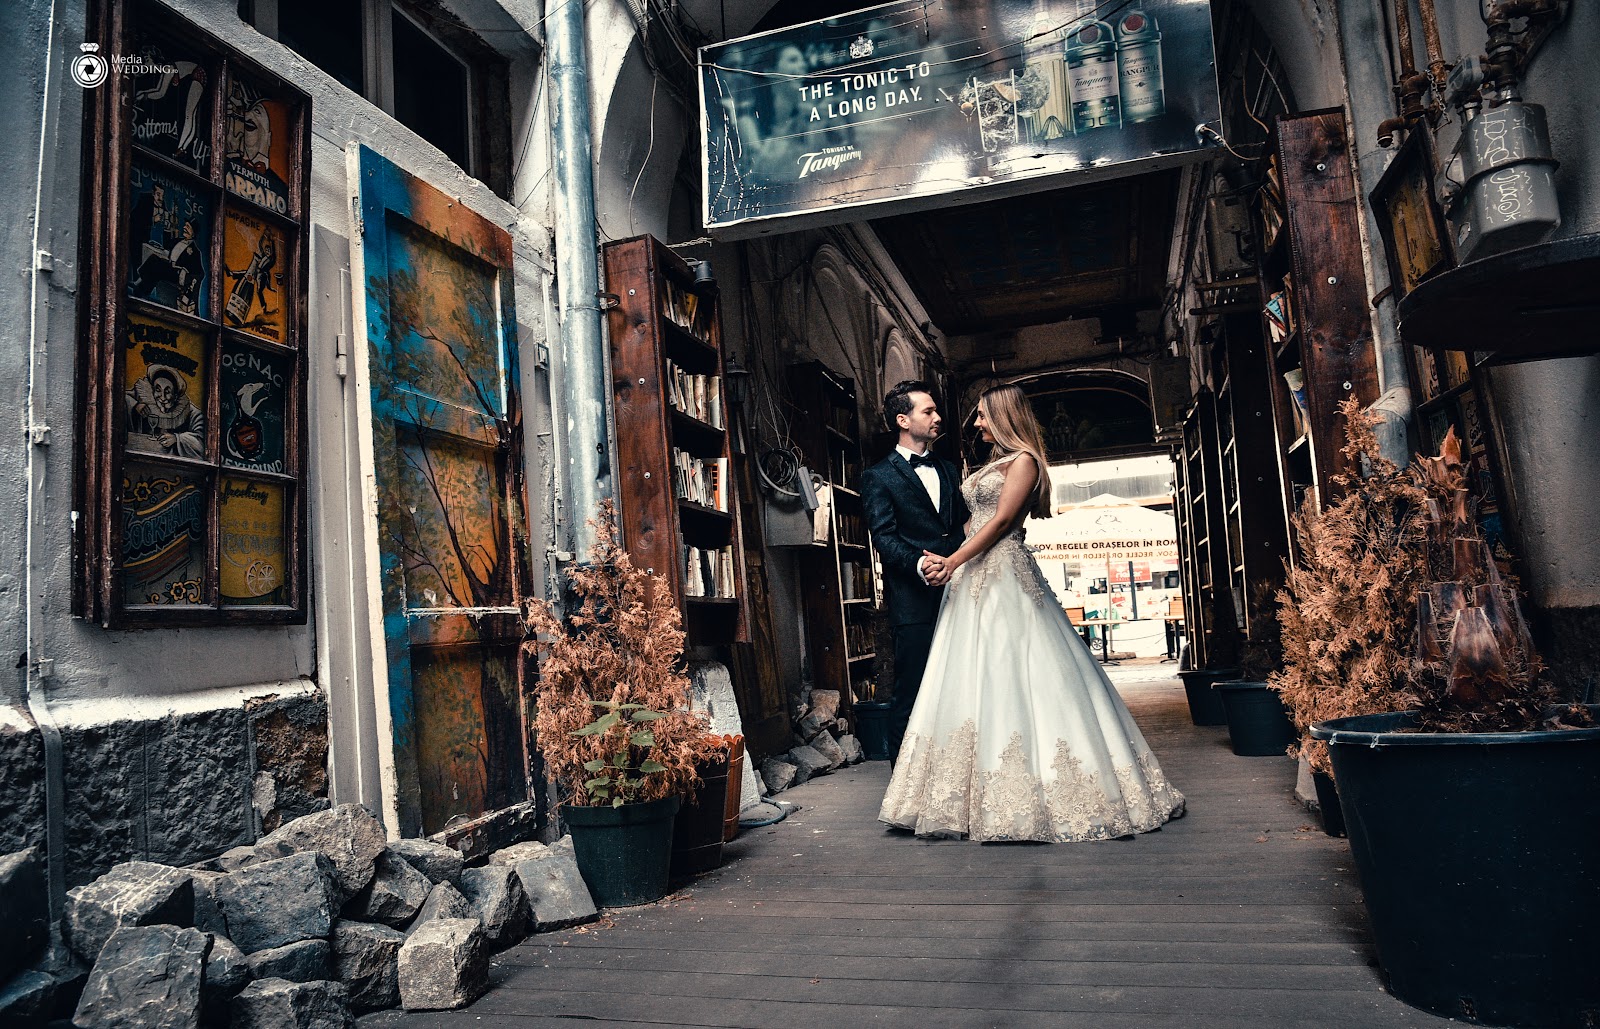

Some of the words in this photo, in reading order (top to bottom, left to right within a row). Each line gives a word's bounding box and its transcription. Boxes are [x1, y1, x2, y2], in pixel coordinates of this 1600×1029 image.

[1119, 64, 1160, 77] RANGPUR
[798, 80, 834, 102] THE
[840, 68, 899, 93] TONIC
[905, 61, 931, 80] TO
[1074, 75, 1113, 88] Tanqueray
[809, 107, 821, 123] A
[827, 95, 877, 119] LONG
[884, 86, 922, 108] DAY.
[822, 146, 846, 154] TONIGHT
[797, 150, 862, 179] Tanqueray
[230, 162, 270, 188] VERMUTH
[1056, 542, 1088, 550] REGELE
